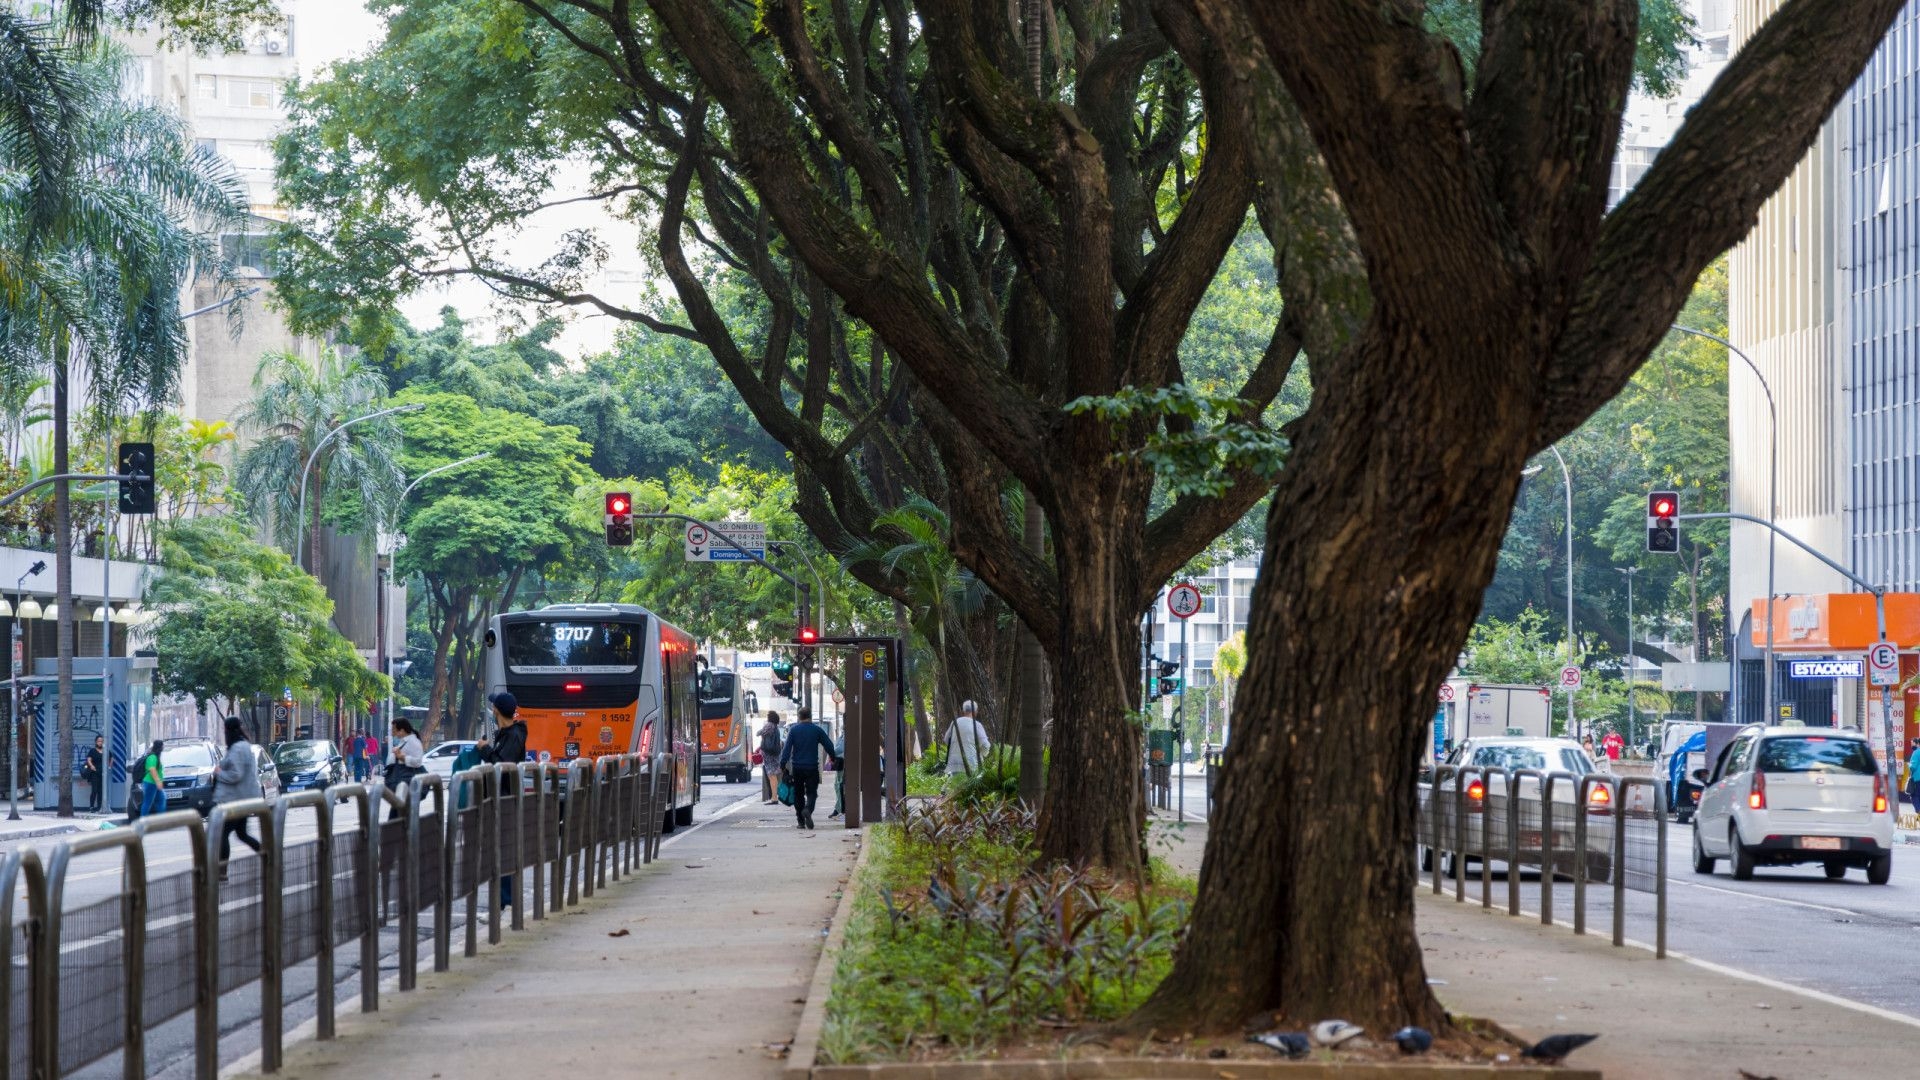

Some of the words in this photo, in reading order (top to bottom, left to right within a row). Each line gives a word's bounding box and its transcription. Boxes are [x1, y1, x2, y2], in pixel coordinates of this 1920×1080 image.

[554, 626, 594, 641] 8707
[1879, 650, 1888, 664] E
[1794, 664, 1858, 676] ESTACIONE
